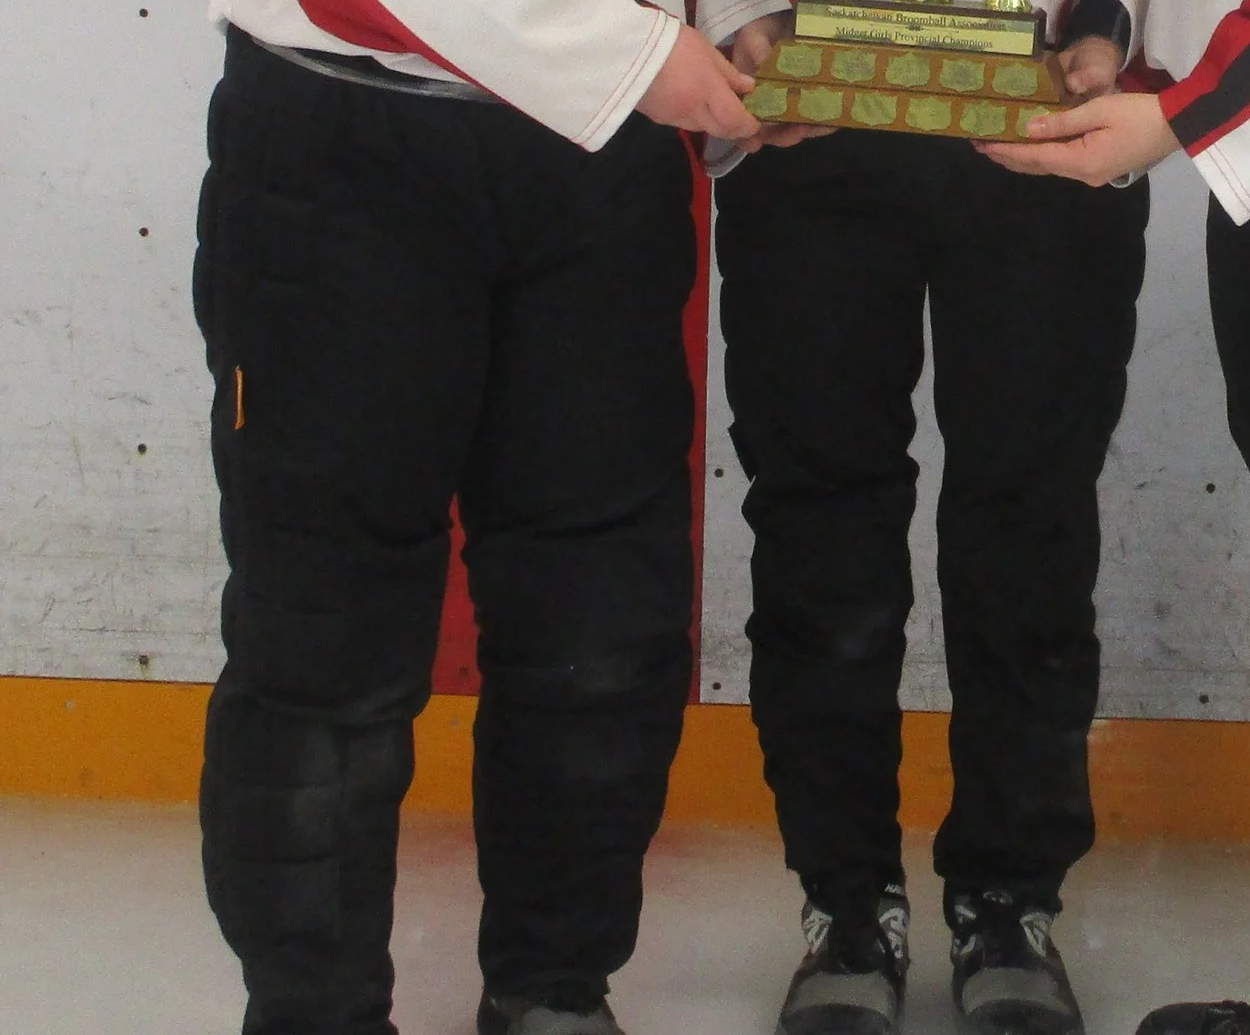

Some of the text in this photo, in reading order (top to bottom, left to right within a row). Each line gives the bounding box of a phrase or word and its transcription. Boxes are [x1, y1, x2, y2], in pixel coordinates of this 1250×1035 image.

[825, 6, 893, 21] Saskatchewan
[896, 13, 947, 27] Broomball
[894, 31, 940, 45] Provincial
[942, 36, 994, 49] Champions
